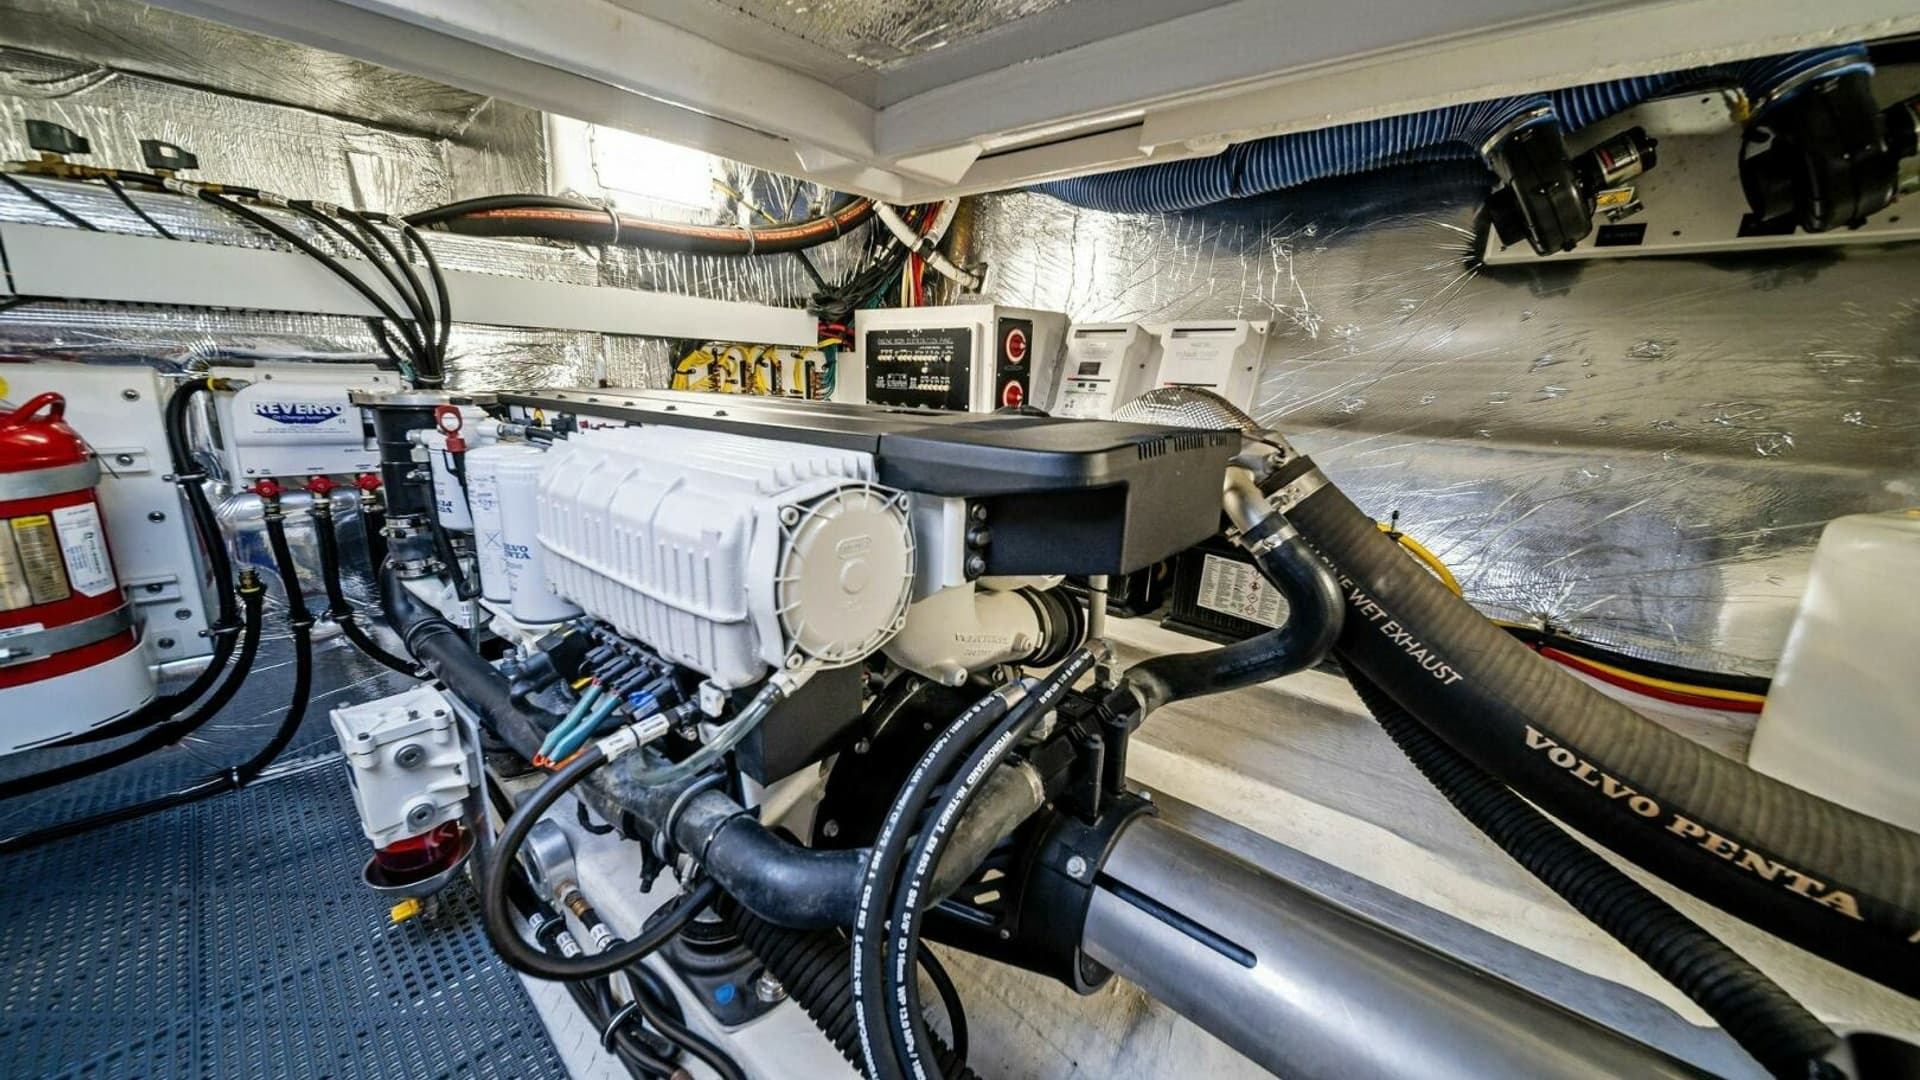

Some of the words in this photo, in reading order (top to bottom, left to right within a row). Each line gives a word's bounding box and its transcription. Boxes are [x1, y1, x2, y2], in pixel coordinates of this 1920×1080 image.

[253, 402, 344, 415] REVERSO
[1348, 588, 1389, 621] WET
[1379, 620, 1464, 686] EXHAUST
[966, 730, 1015, 788] HYDROSCAND
[1524, 724, 1661, 819] VOLVO
[1664, 813, 1865, 922] PENTA
[898, 937, 908, 951] ID
[897, 986, 907, 1006] WP
